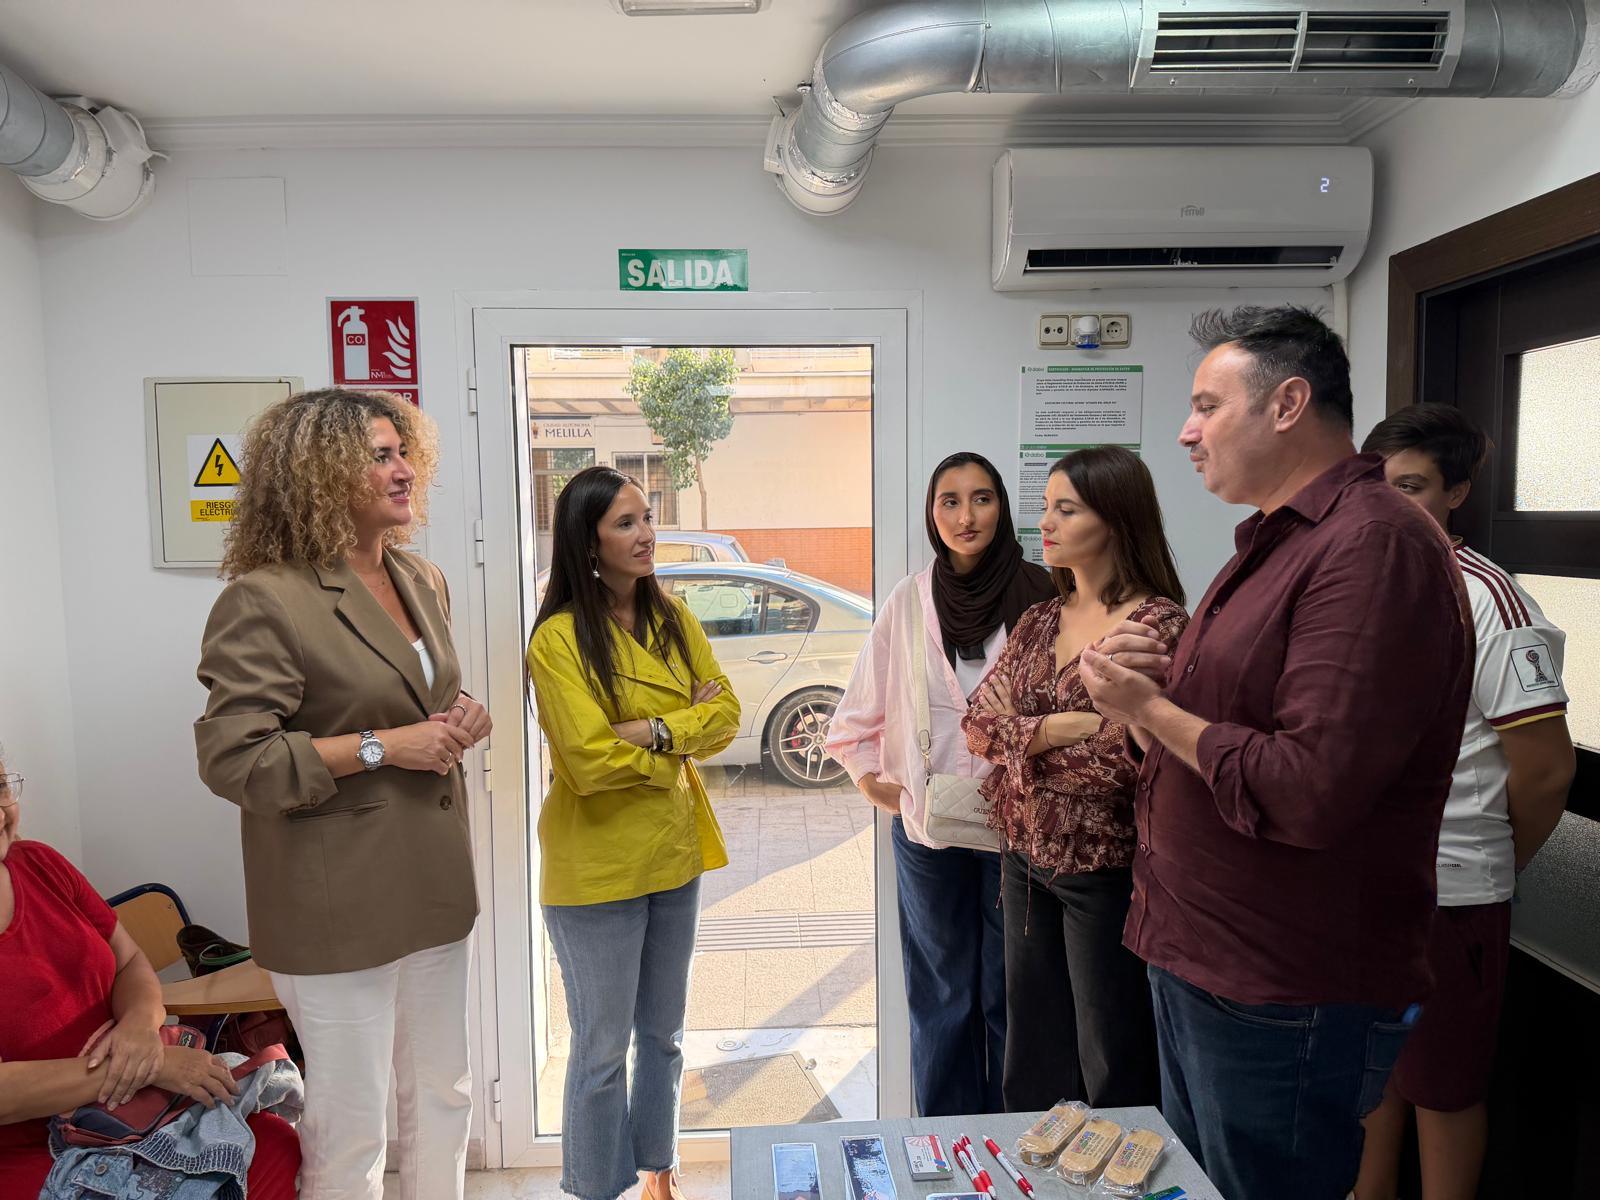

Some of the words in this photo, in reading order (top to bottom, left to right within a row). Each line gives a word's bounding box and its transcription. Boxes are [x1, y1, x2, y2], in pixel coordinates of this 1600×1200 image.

[1320, 177, 1330, 193] 2
[627, 259, 734, 287] SALIDA
[545, 428, 592, 438] MELILLA
